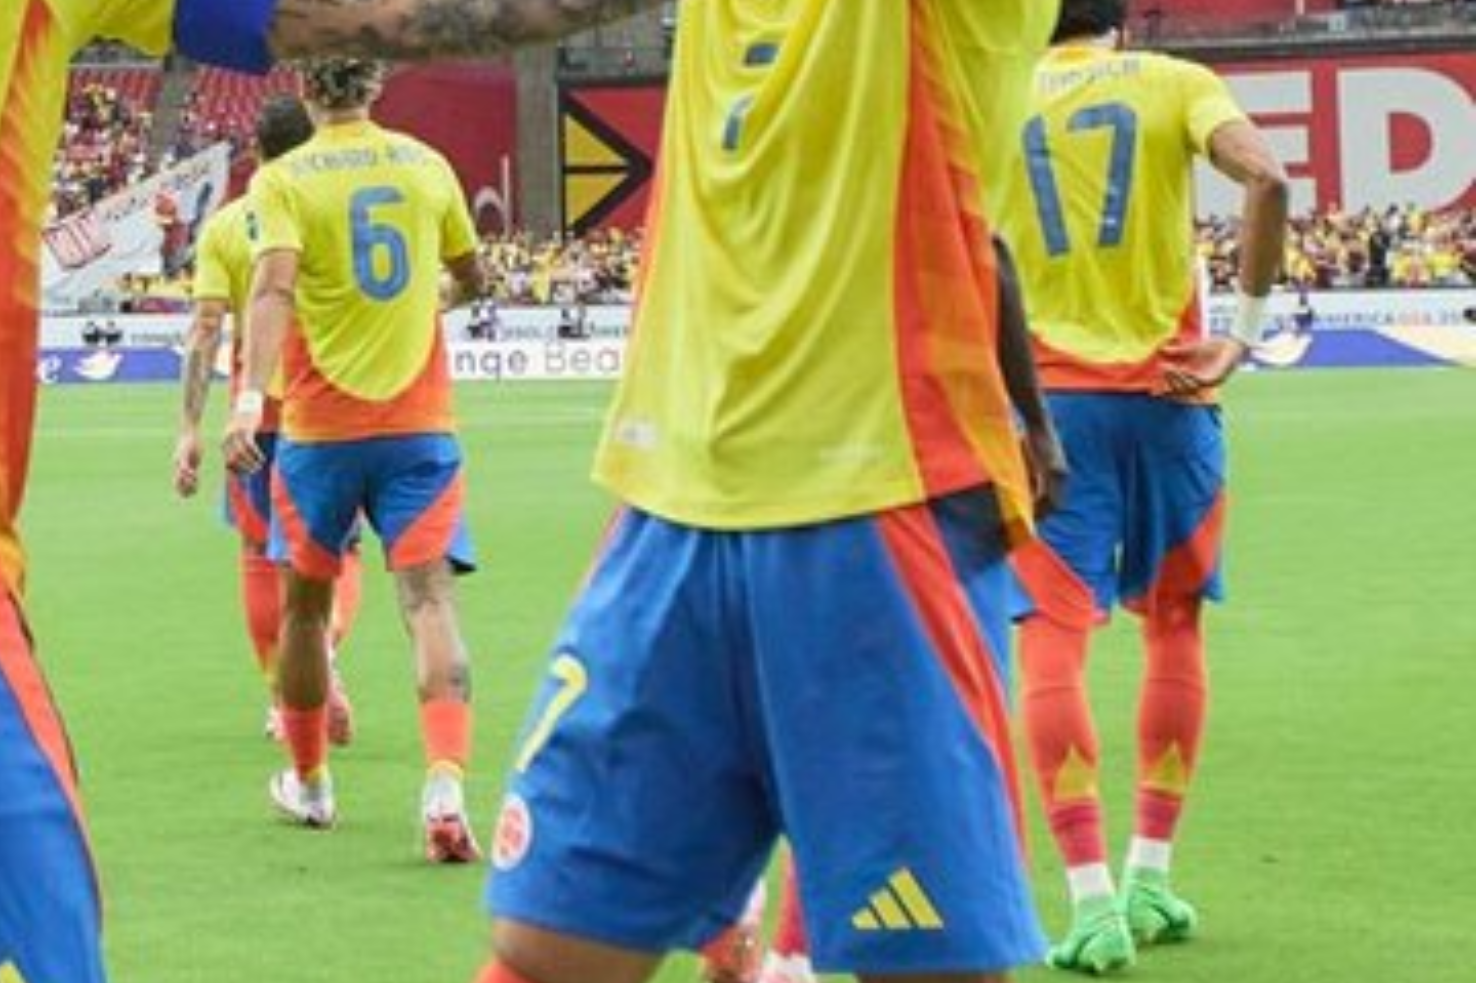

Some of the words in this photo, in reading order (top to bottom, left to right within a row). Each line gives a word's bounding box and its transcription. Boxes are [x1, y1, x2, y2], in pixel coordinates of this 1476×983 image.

[1021, 102, 1136, 257] 17
[349, 185, 412, 301] 6
[454, 348, 528, 382] nge
[544, 343, 620, 373] Bea
[516, 653, 588, 774] 7
